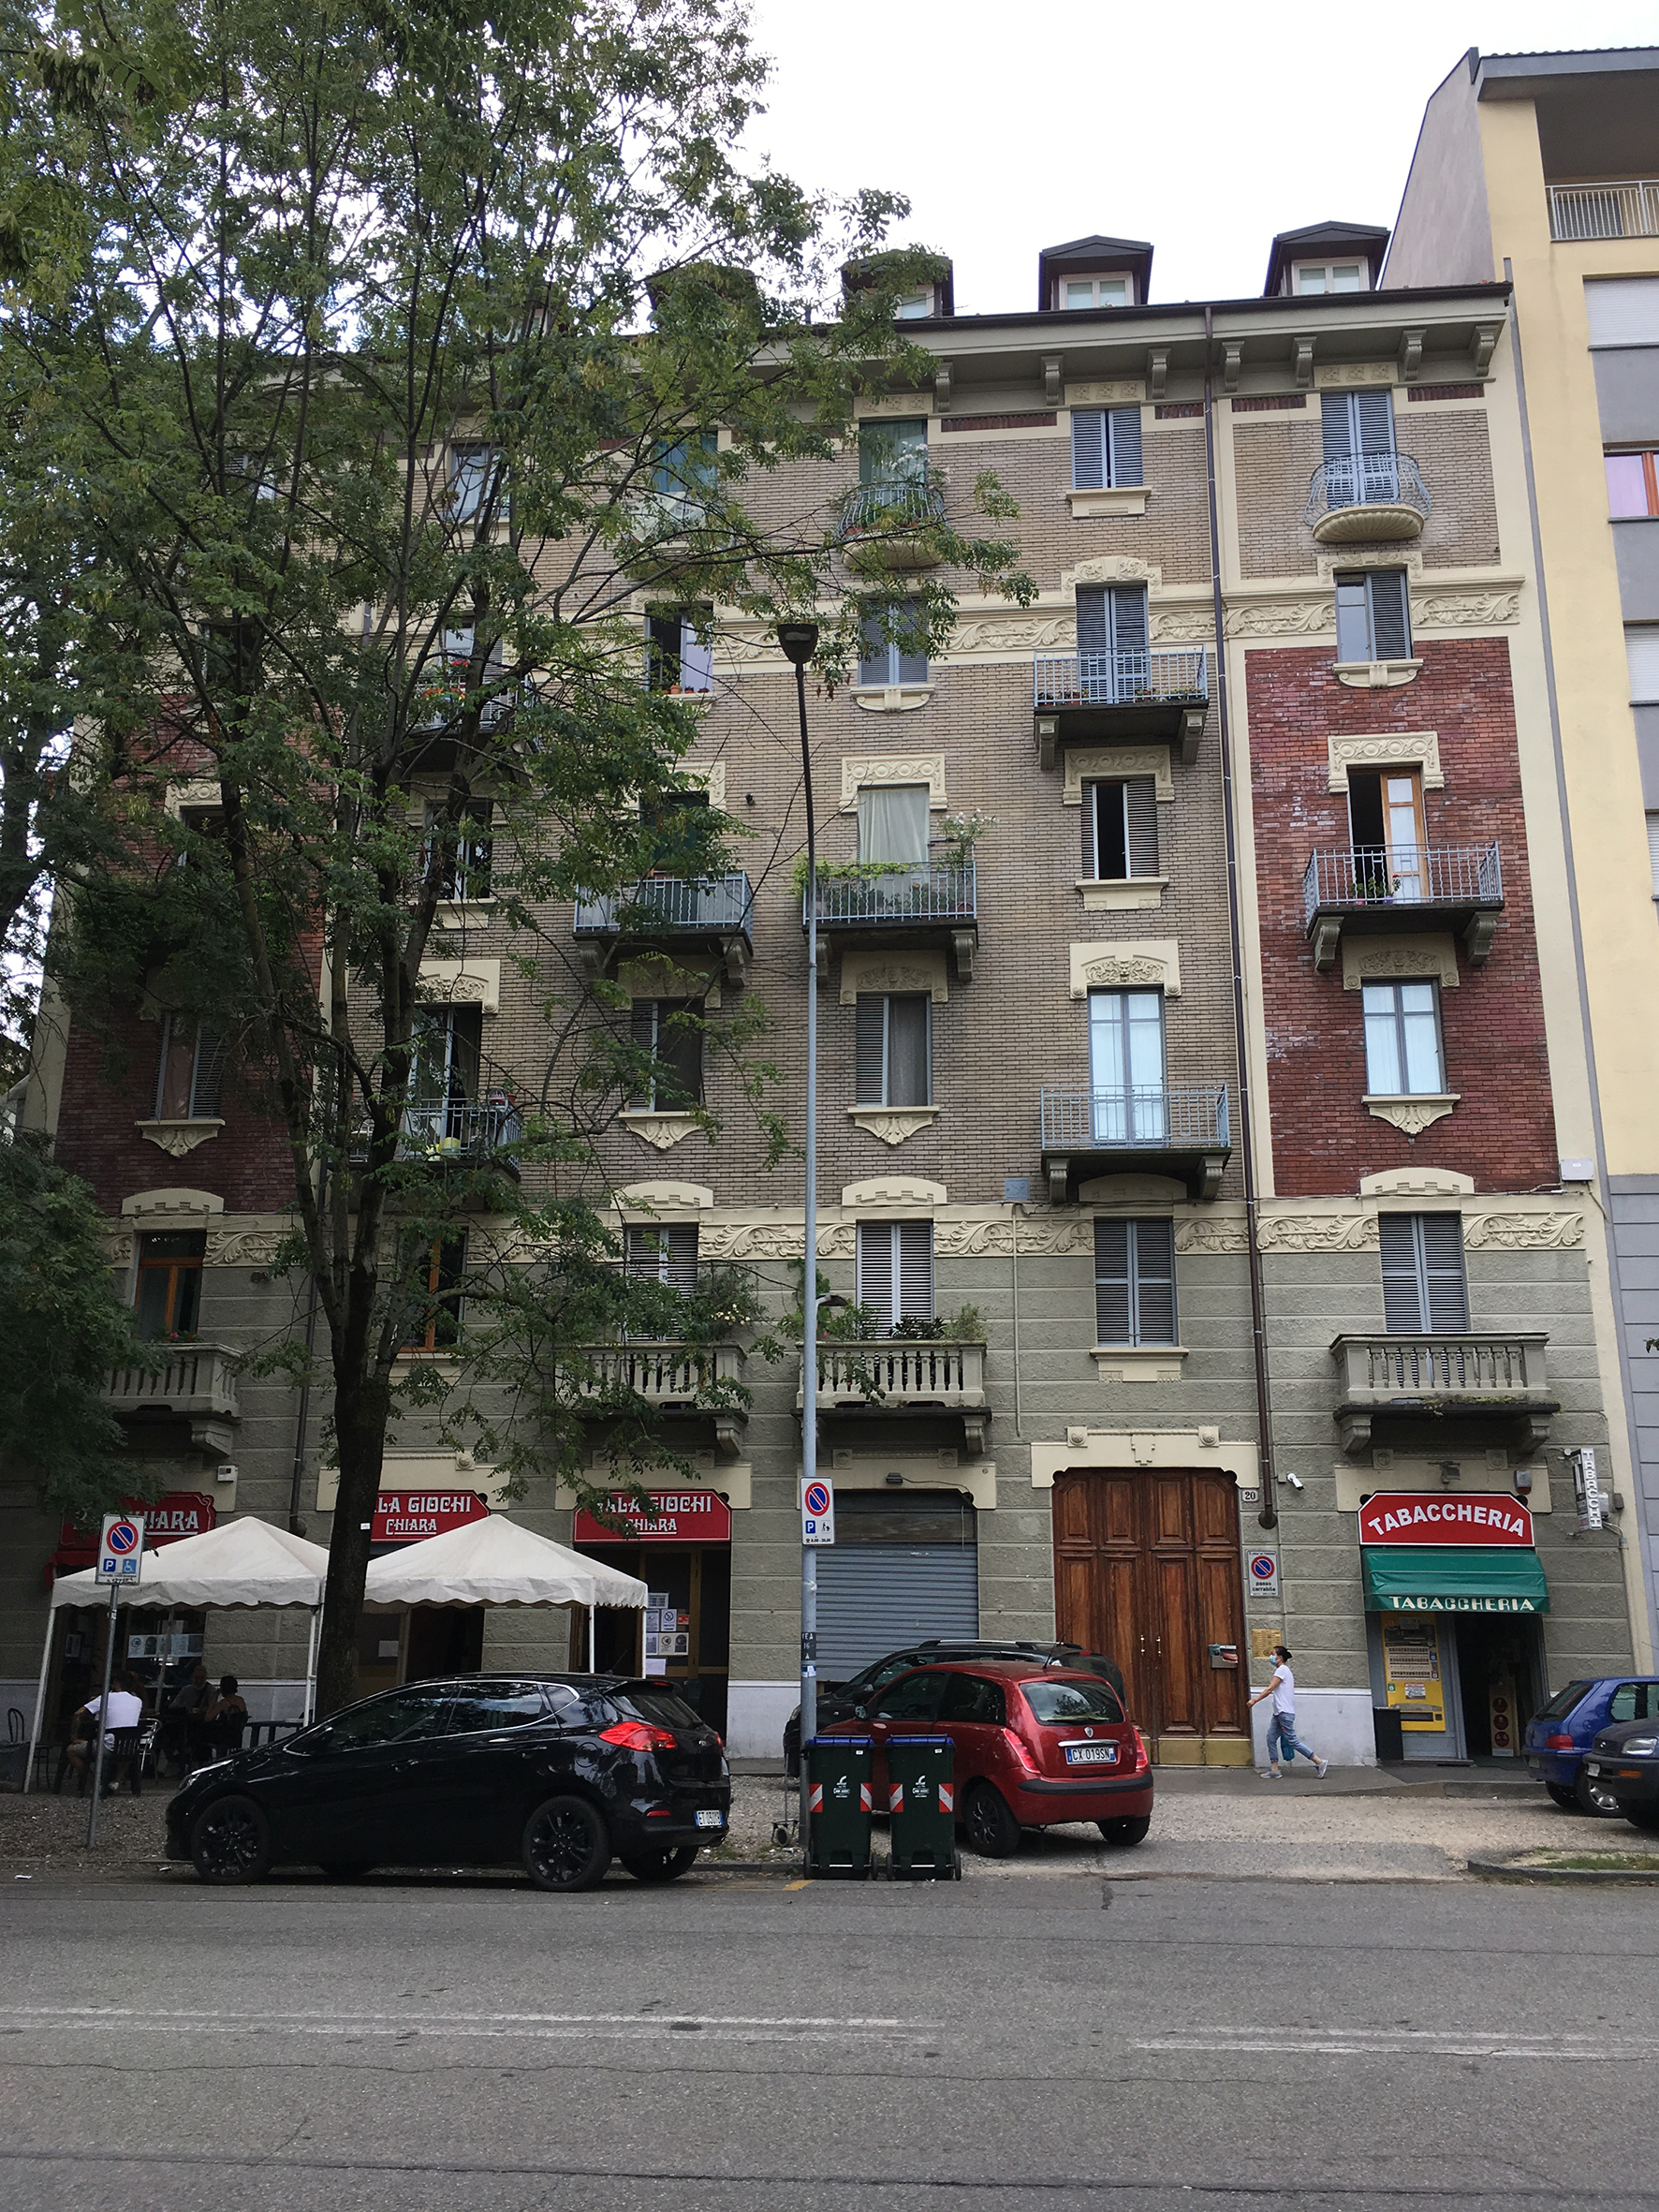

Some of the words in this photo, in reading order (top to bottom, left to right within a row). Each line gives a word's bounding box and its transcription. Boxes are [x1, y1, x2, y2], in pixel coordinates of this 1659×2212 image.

[1244, 1491, 1255, 1500] 20
[1582, 1450, 1602, 1529] TABACCHI
[374, 1497, 402, 1513] LA
[407, 1496, 472, 1513] GIOCHI
[385, 1518, 437, 1535] CHIARA
[807, 1522, 814, 1532] P
[1367, 1503, 1524, 1538] TABACCHERIA
[105, 1560, 114, 1571] P
[1388, 1596, 1534, 1611] TABACCHERIA
[1072, 1749, 1083, 1761] CX
[1086, 1748, 1110, 1760] 019SN
